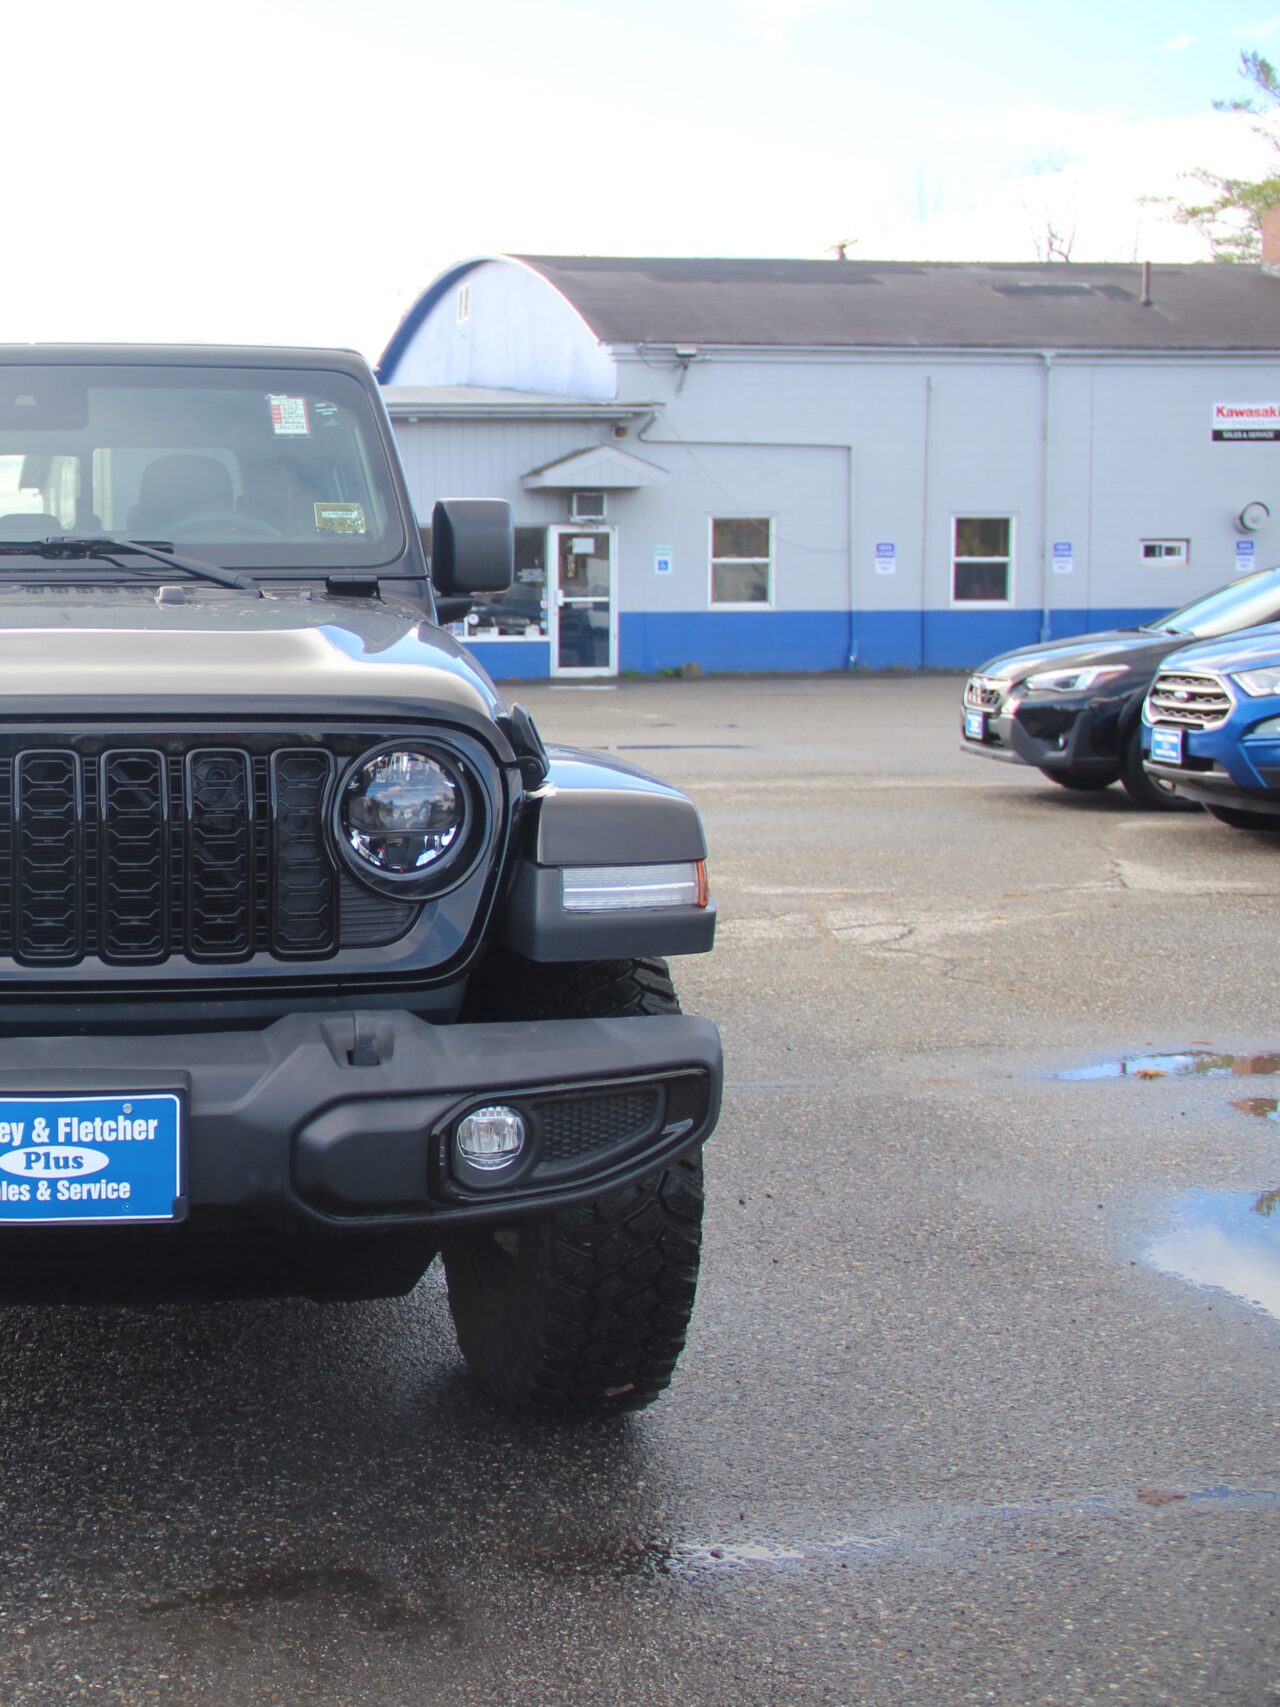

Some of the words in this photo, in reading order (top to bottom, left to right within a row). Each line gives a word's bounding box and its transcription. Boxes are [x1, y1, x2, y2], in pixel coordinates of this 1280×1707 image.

[31, 1117, 50, 1142] &
[58, 1115, 158, 1143] Fletcher
[23, 1151, 84, 1170] Plus
[36, 1181, 51, 1201] &
[57, 1179, 131, 1201] Service
